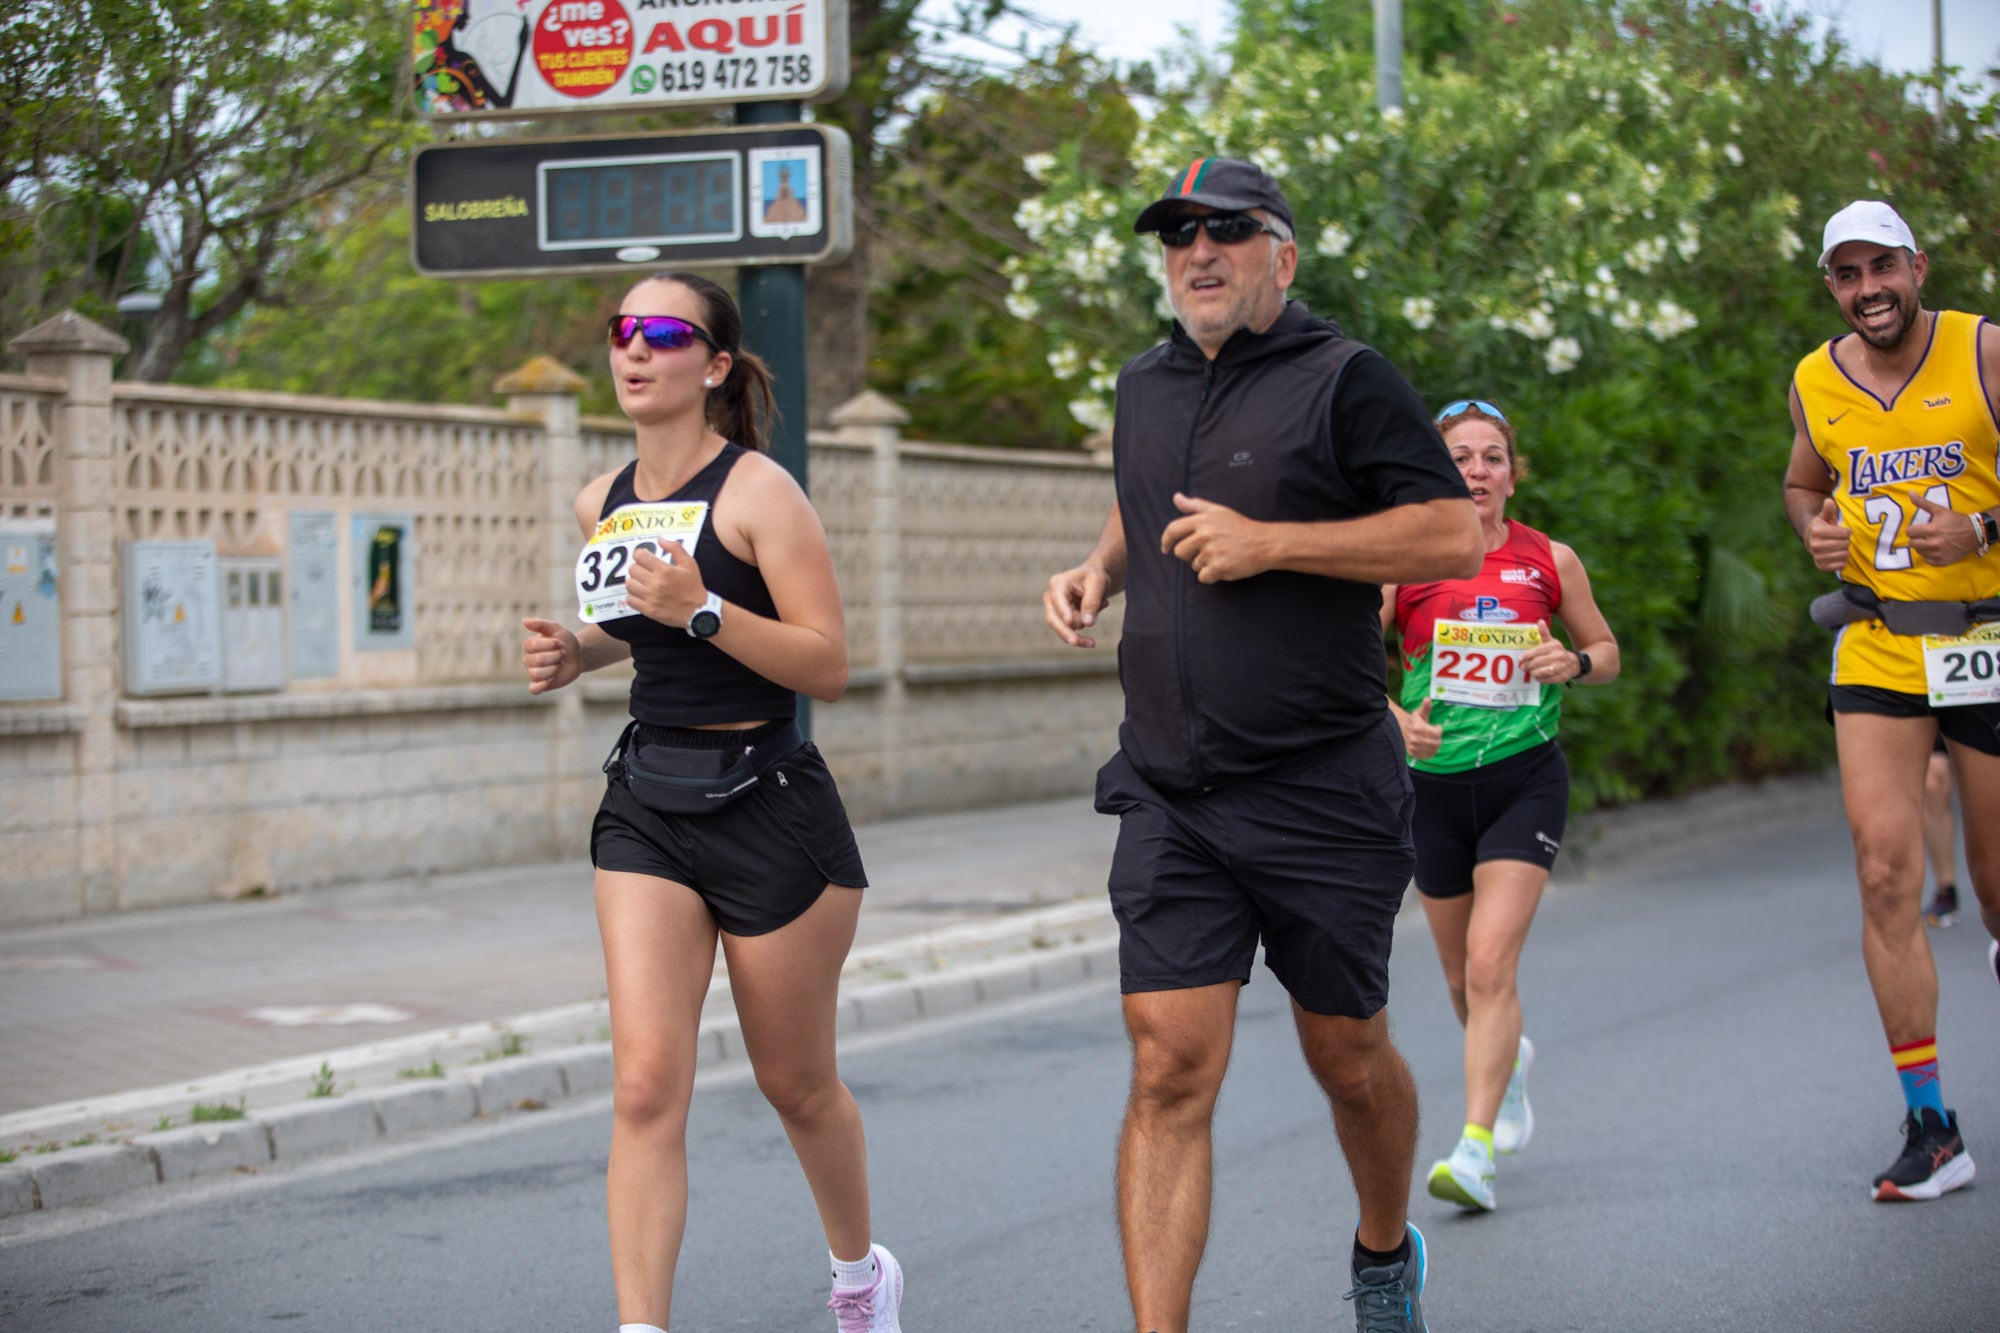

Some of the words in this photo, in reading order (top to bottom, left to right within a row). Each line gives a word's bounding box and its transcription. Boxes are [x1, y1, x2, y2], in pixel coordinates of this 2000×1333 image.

[543, 1, 605, 32] ¿me
[643, 4, 806, 54] AQUÍ
[562, 18, 630, 48] ves?
[538, 53, 566, 69] TUS
[566, 48, 629, 67] CLIENTES
[662, 61, 705, 91] 619
[714, 57, 757, 88] 472
[768, 54, 811, 85] 758
[424, 194, 529, 222] SALOBREÑA
[1846, 440, 1966, 496] LAKERS
[581, 539, 684, 592] 32
[1451, 627, 1469, 642] 38
[1943, 650, 2000, 683] 20
